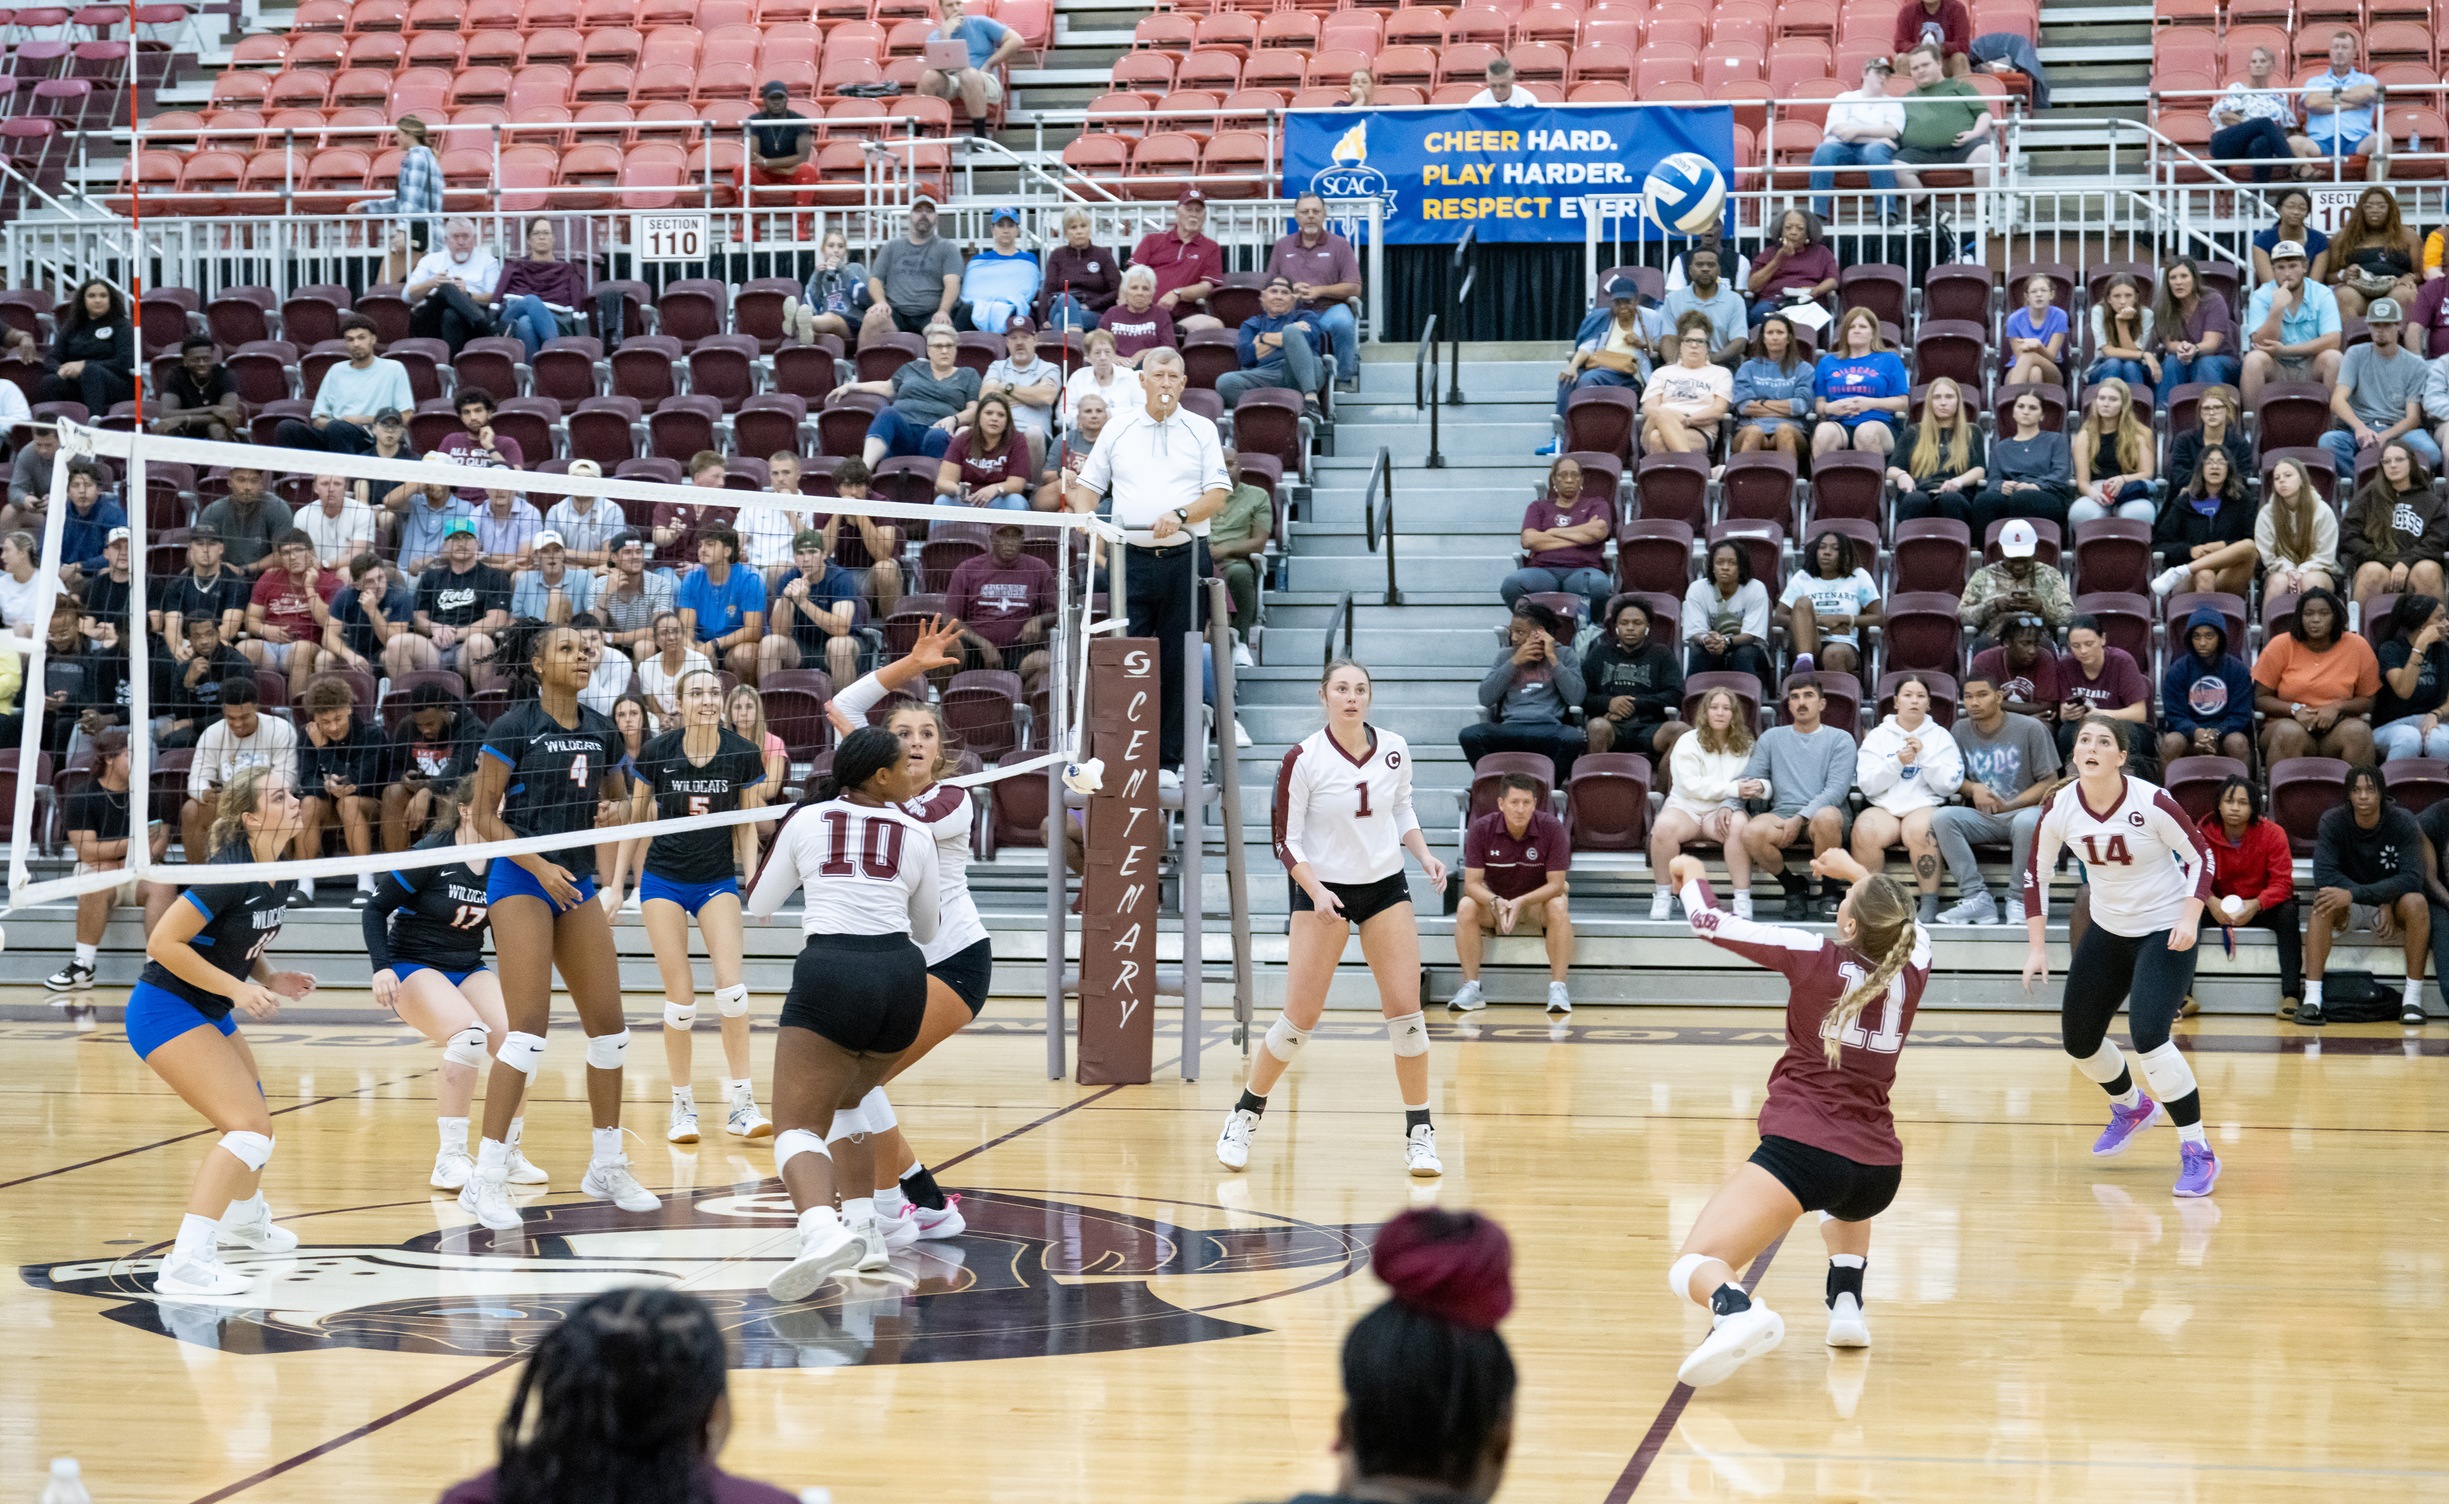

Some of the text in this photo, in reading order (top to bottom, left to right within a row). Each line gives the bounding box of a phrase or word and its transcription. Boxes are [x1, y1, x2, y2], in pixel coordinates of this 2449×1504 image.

[1425, 129, 1617, 153] CHEER HARD.
[1423, 163, 1632, 186] PLAY HARDER.
[1322, 176, 1375, 197] SCAC
[1423, 197, 1552, 220] RESPECT
[2319, 193, 2356, 204] SECTI
[649, 219, 698, 231] SECTION
[649, 232, 697, 256] 110
[450, 447, 468, 457] ALL
[1808, 592, 1858, 603] NTENARY
[544, 740, 602, 754] WILDCATS
[570, 754, 588, 789] 4
[671, 780, 729, 794] WILDCATS
[689, 797, 710, 816] 5
[1354, 781, 1374, 821] 1
[819, 809, 907, 883] 10
[2081, 834, 2134, 868] 14
[1112, 691, 1151, 1030] CENTENARY
[448, 884, 487, 905] WILDCA
[450, 905, 488, 931] 17
[245, 931, 277, 961] 11
[1820, 961, 1907, 1055] 11
